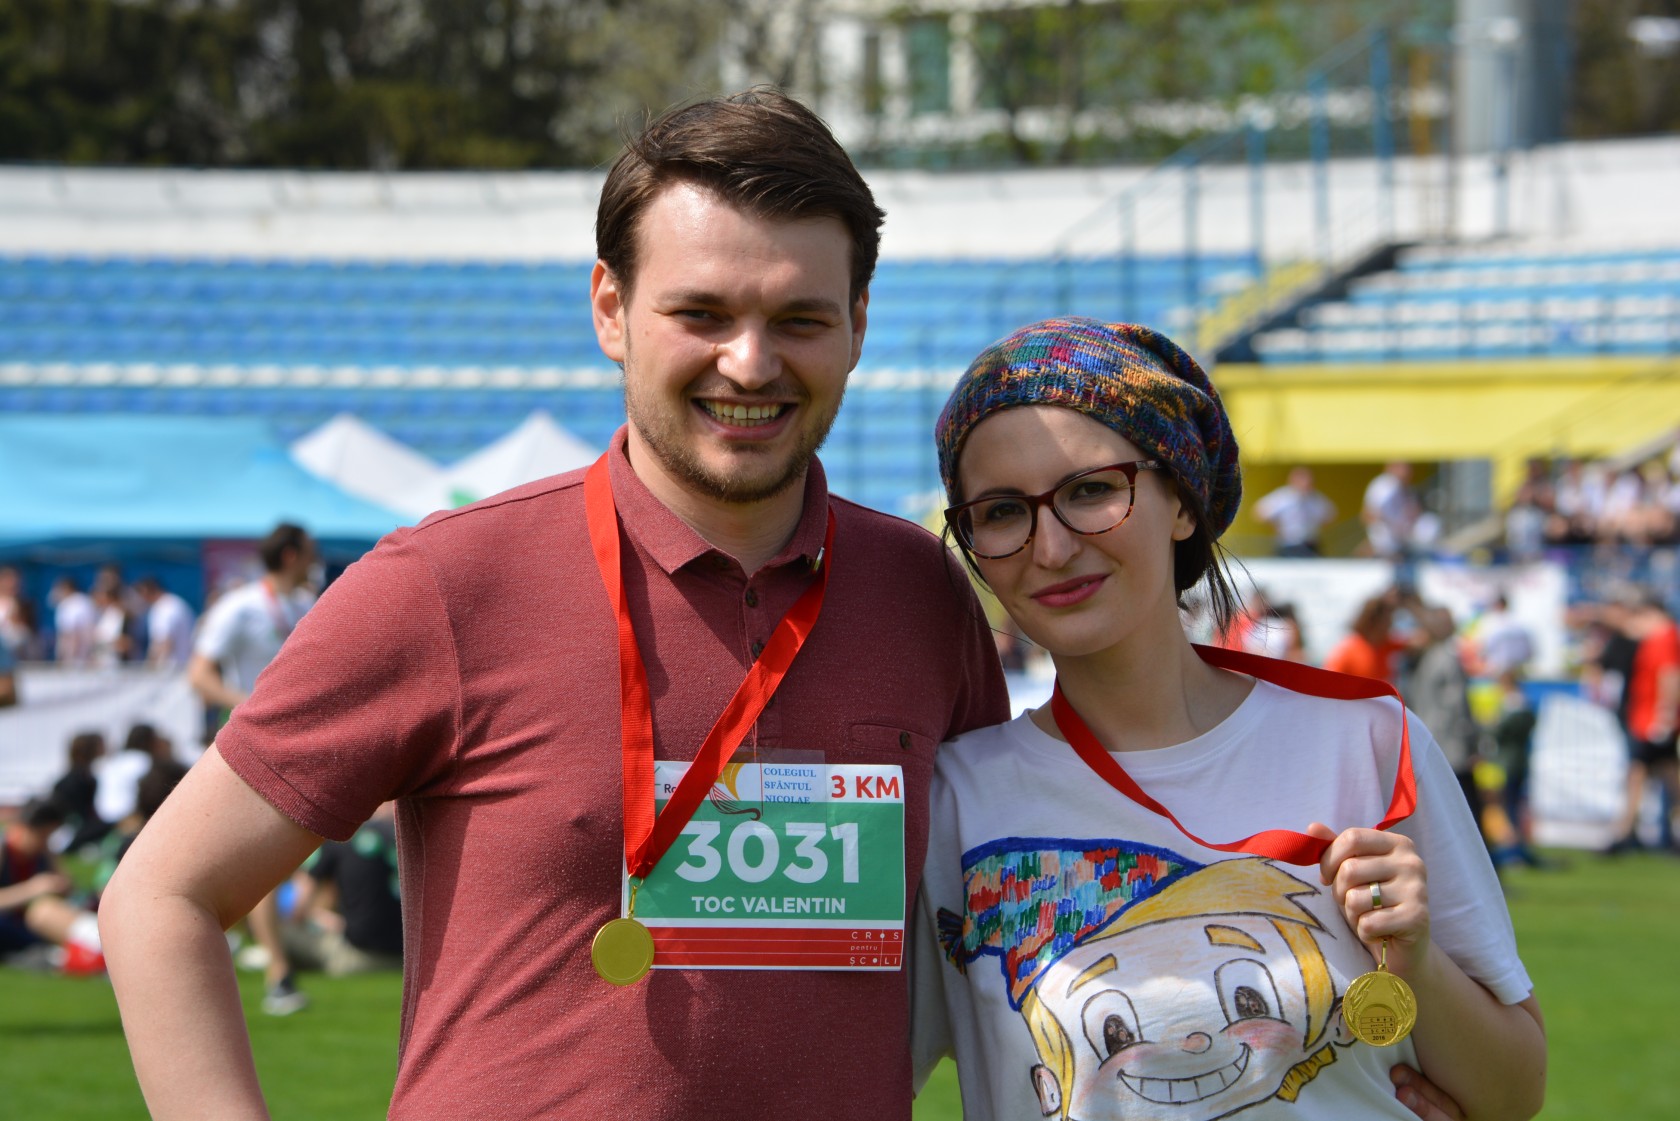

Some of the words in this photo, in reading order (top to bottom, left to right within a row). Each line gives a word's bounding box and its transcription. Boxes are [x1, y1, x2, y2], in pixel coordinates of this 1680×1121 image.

[763, 767, 817, 777] COLEGIUL
[764, 780, 812, 791] SFÂNTUL
[831, 775, 846, 799] 3
[855, 776, 900, 799] KM
[764, 795, 811, 804] NICOLAE
[675, 820, 860, 884] 3031
[691, 896, 736, 913] TOC
[741, 897, 846, 914] VALENTIN
